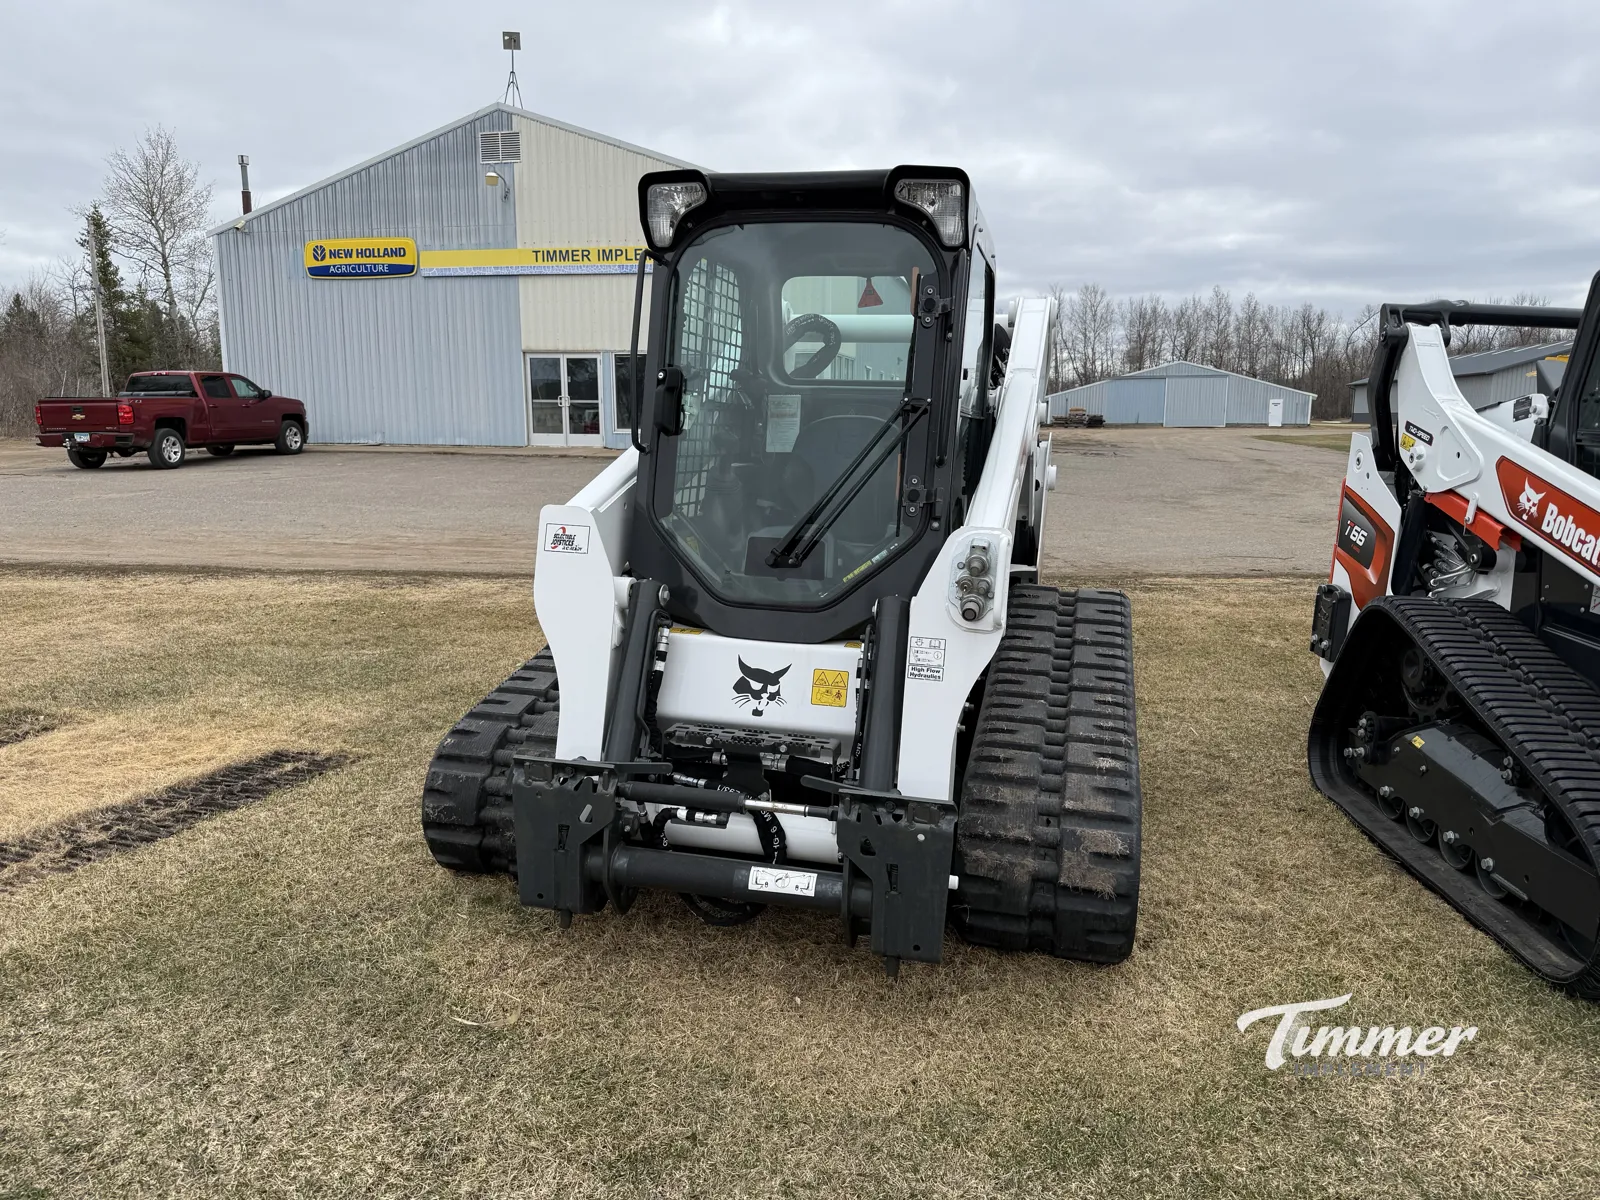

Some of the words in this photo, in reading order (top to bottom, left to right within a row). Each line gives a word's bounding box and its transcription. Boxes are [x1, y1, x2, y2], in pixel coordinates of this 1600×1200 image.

[329, 248, 353, 259] NEW
[356, 247, 406, 258] HOLLAND
[532, 249, 591, 262] TIMMER
[597, 248, 651, 262] IMPLE
[329, 264, 389, 273] AGRICULTURE
[1344, 520, 1368, 546] T66
[910, 671, 941, 679] Hydraulics
